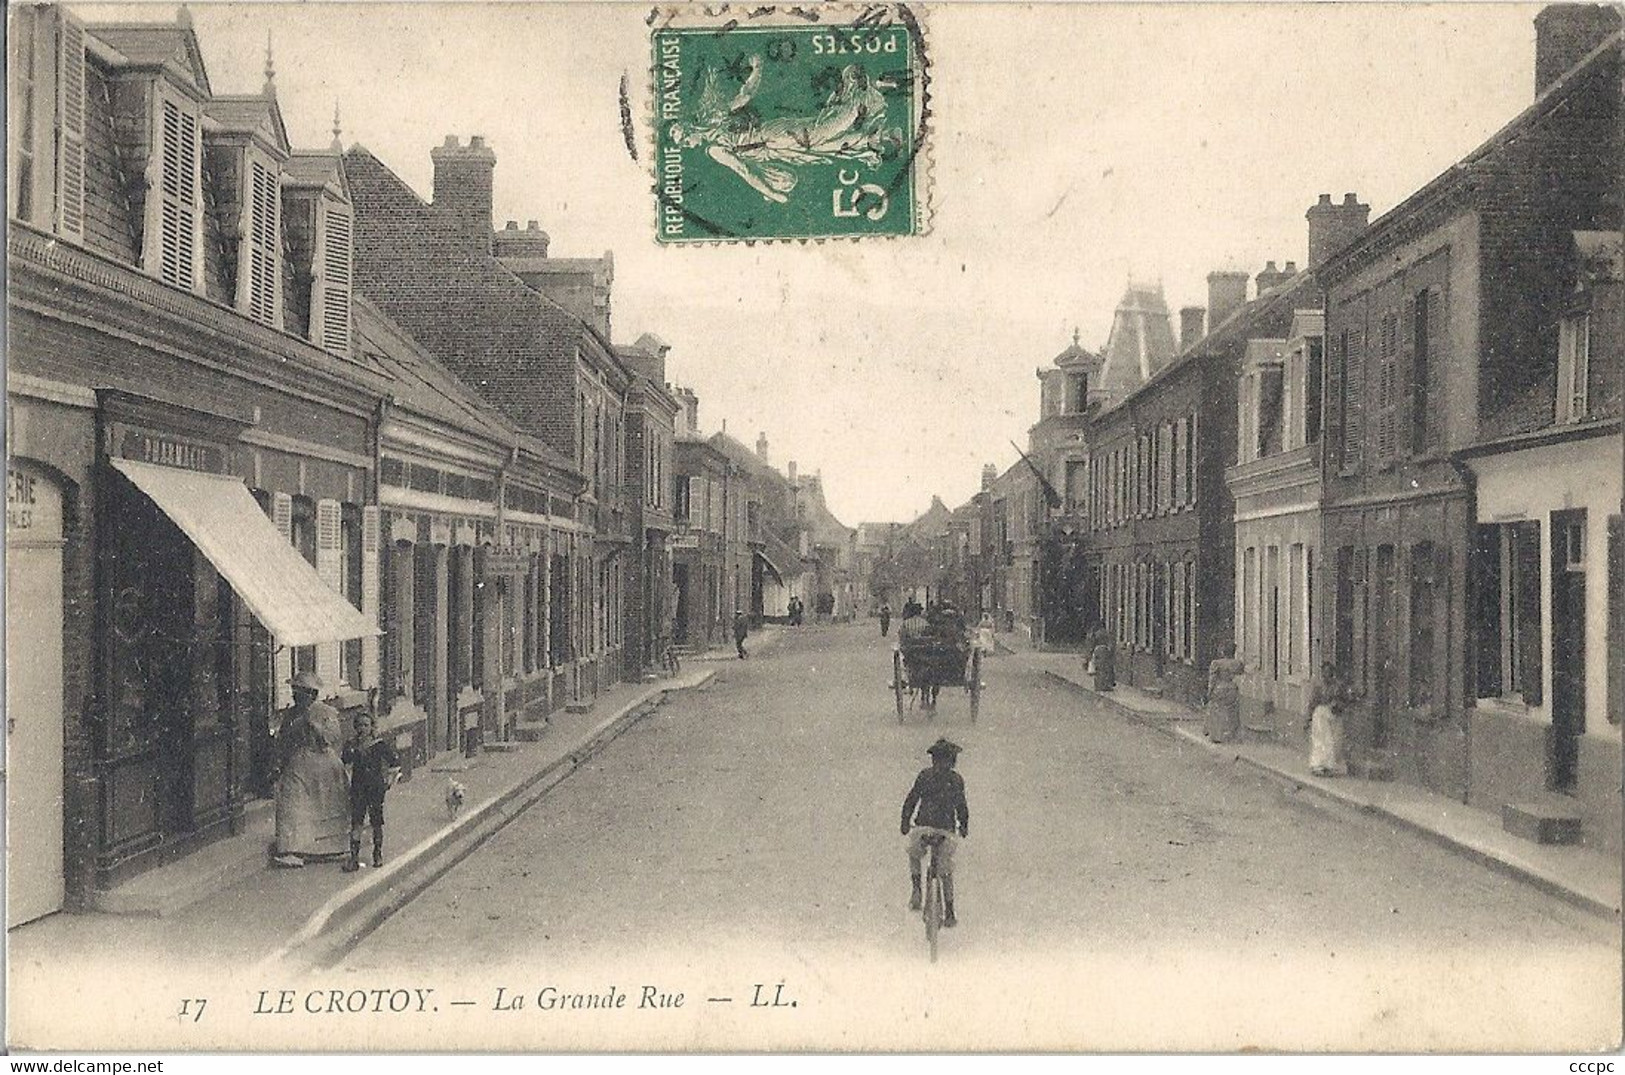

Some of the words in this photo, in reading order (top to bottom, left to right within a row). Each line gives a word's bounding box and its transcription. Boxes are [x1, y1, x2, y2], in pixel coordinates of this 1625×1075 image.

[811, 33, 897, 54] POSTES
[662, 36, 682, 120] FRANÇAISE
[180, 999, 206, 1022] 17
[253, 990, 296, 1014] LE
[304, 988, 438, 1014] CROTOY.
[492, 987, 525, 1011] La
[536, 986, 627, 1010] Grande
[637, 985, 685, 1009] Rue
